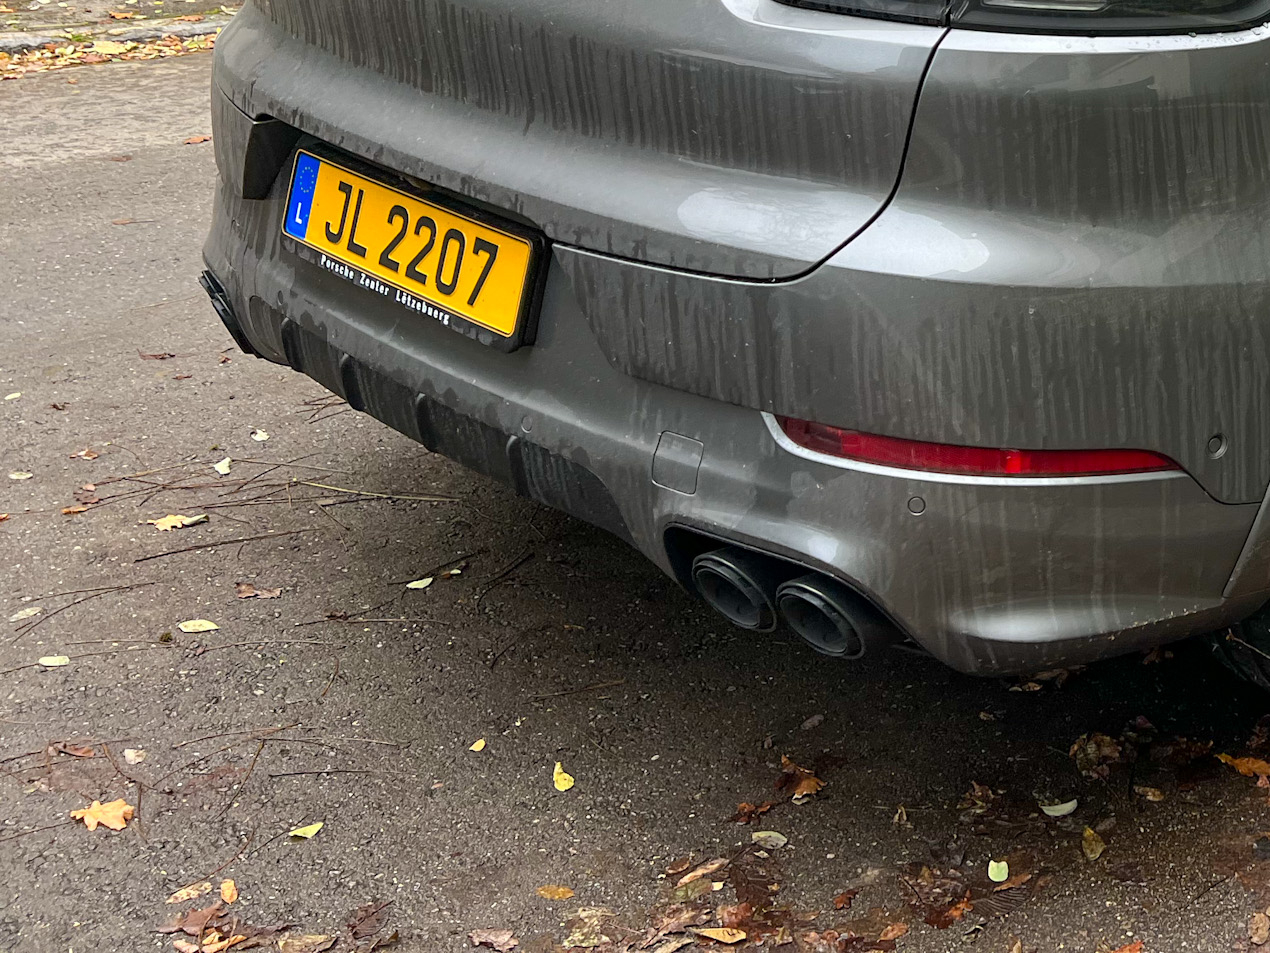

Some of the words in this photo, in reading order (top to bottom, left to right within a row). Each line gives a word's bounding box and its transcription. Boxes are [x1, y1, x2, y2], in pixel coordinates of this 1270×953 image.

[295, 202, 303, 224] L
[325, 181, 367, 258] JL
[378, 204, 499, 307] 2207
[320, 254, 355, 280] Porsche
[359, 273, 390, 296] Zenter
[395, 289, 450, 326] Lëtzebuerg
